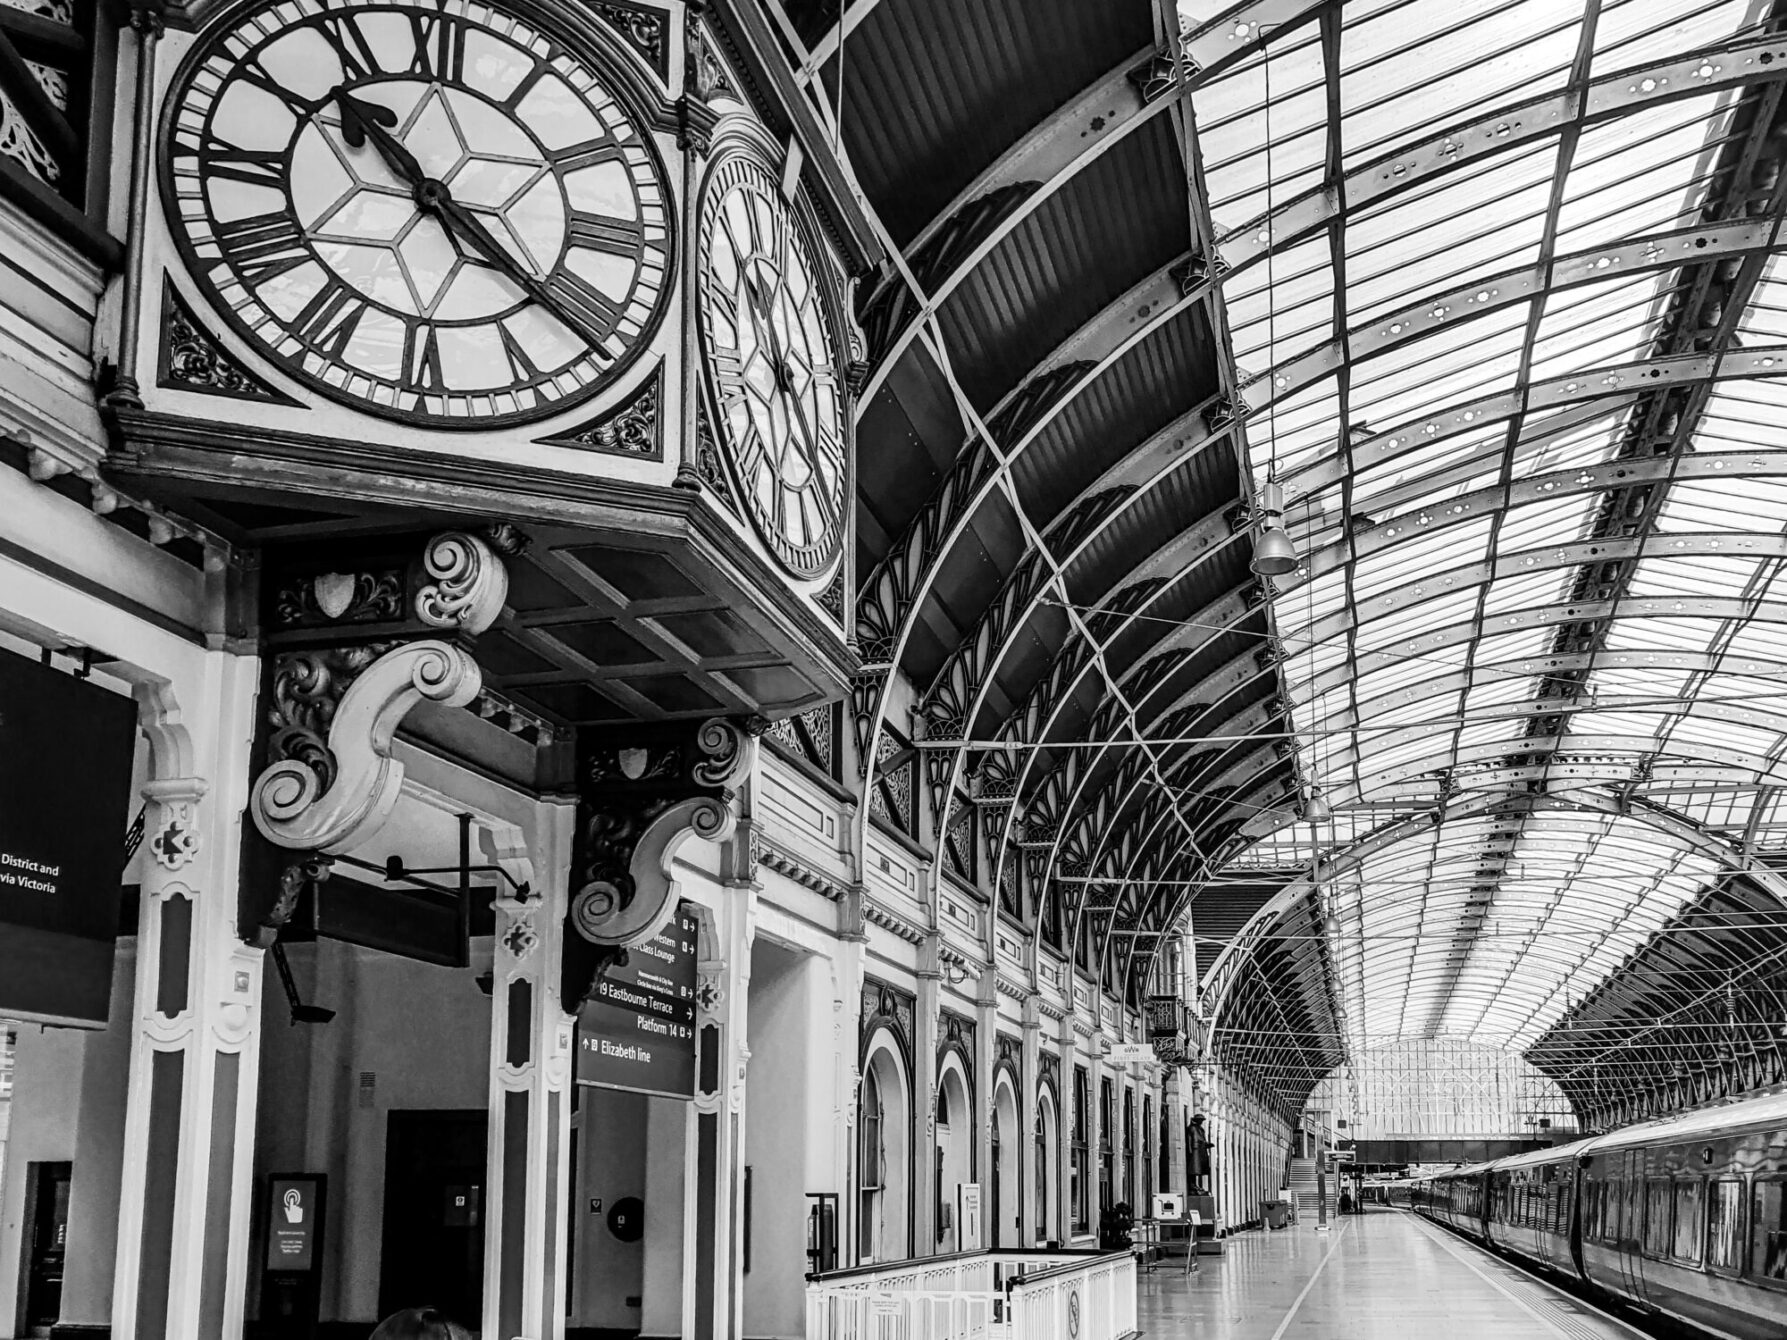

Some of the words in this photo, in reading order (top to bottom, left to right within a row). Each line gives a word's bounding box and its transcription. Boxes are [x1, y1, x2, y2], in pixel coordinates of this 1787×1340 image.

[408, 12, 467, 82] XII
[566, 208, 642, 263] III
[1, 853, 39, 872] District
[40, 865, 60, 877] and
[0, 872, 16, 885] via
[17, 875, 56, 894] Victoria
[654, 946, 676, 964] Lounge
[608, 984, 648, 1007] Eastbourne
[648, 995, 673, 1014] Terrace
[637, 1015, 667, 1036] Platform
[668, 1023, 677, 1038] 14
[601, 1039, 636, 1060] Elizabeth
[637, 1047, 651, 1063] line
